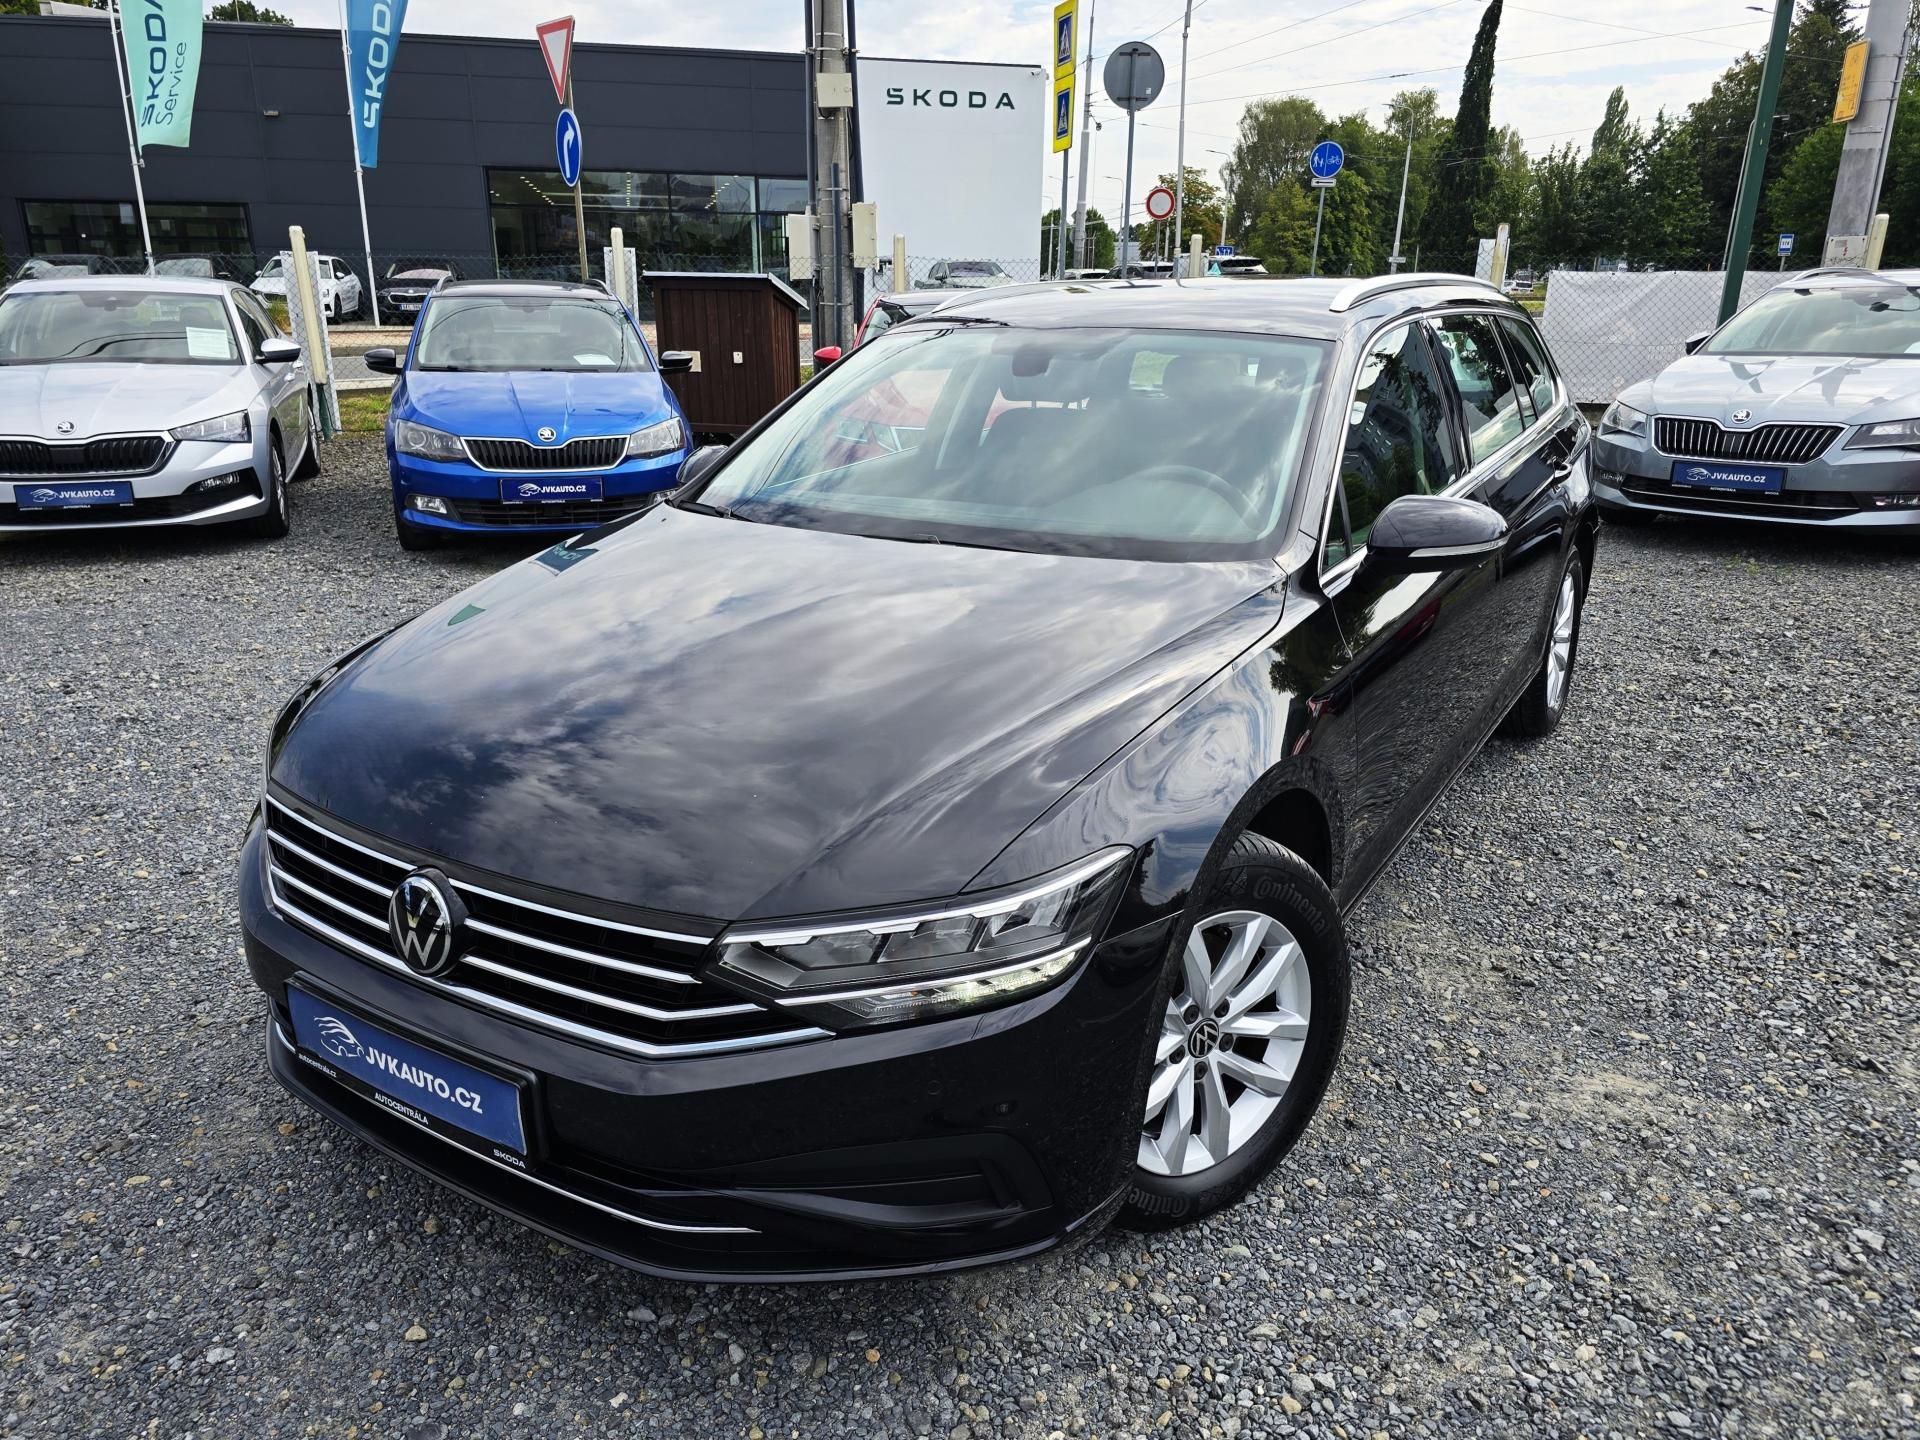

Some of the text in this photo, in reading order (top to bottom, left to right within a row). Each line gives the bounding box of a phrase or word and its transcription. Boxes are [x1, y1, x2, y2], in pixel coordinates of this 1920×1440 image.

[363, 0, 391, 128] SKOD
[155, 42, 187, 125] Service
[59, 489, 115, 499] JVKAUTO.CZ
[540, 485, 587, 493] JVKAUTO.CZ
[1711, 472, 1766, 483] JVKAUTO.CZ
[1253, 876, 1331, 937] Continental
[365, 1046, 483, 1114] JVKAUTO.CZ
[374, 1092, 429, 1125] AUTOCENTRÁLA
[1127, 1186, 1190, 1218] Contine
